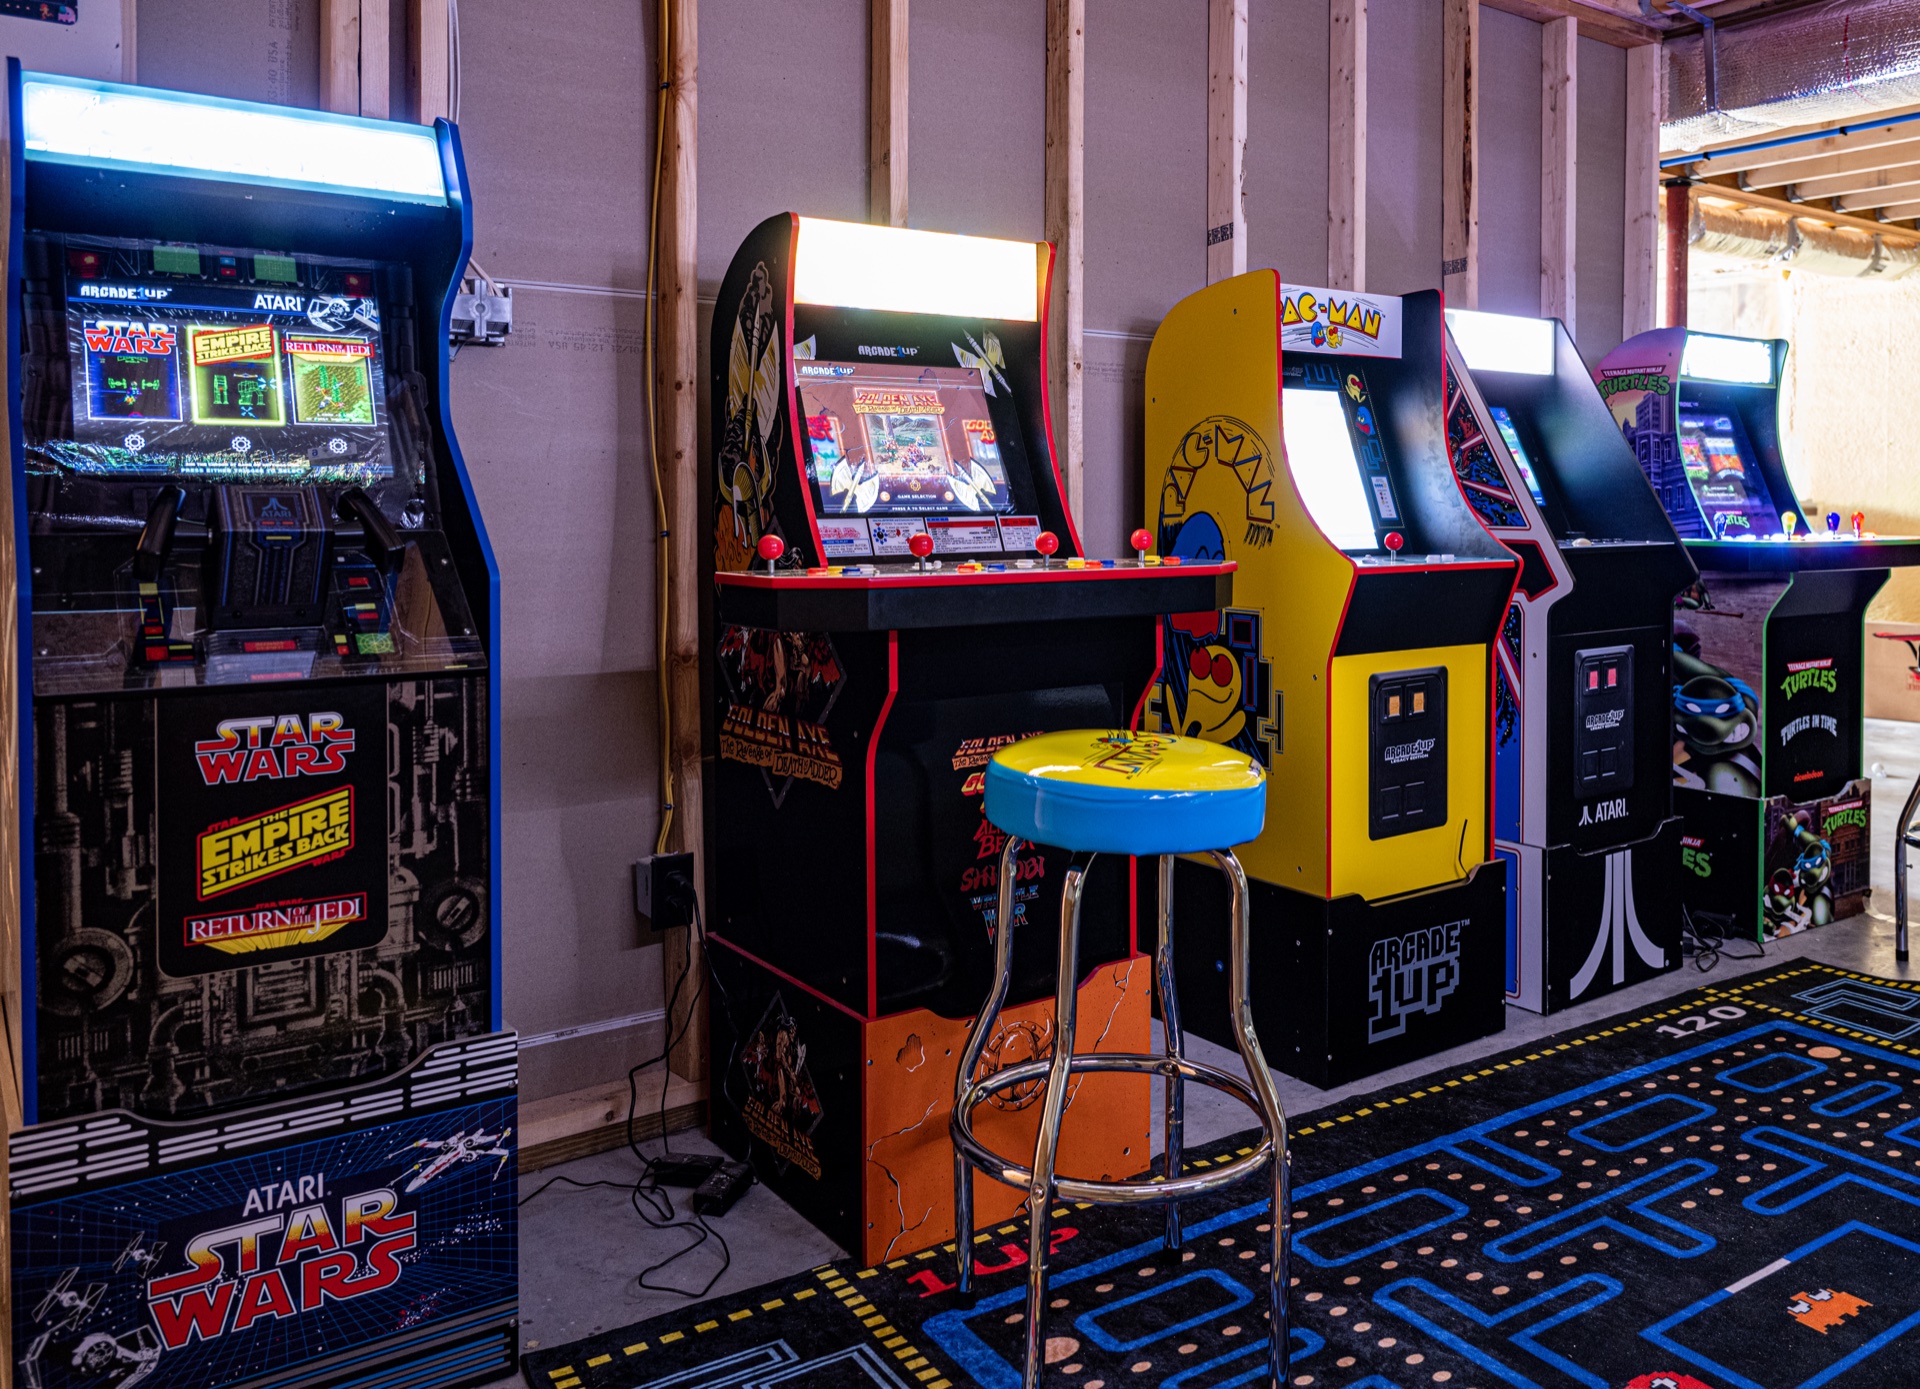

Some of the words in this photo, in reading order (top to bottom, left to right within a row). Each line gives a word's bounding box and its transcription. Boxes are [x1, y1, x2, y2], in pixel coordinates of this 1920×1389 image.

[268, 41, 278, 63] USA
[254, 294, 302, 312] ATARI
[1280, 291, 1382, 340] AC-MAN
[85, 320, 175, 339] STAR
[86, 336, 177, 355] WARS
[195, 329, 272, 352] EMPIRE
[548, 341, 568, 350] USA
[196, 347, 243, 360] STRIKES
[244, 341, 271, 357] BACK
[286, 341, 335, 353] RETURN
[345, 343, 370, 359] JEDI
[854, 392, 911, 407] GOLDEN
[911, 394, 944, 407] AXE
[1598, 373, 1670, 400] TURTLES
[966, 419, 992, 432] GOL
[1780, 667, 1837, 701] TURTLES
[195, 711, 355, 755] STAR
[723, 704, 793, 752] GOLDEN
[796, 719, 840, 763] AXE
[955, 735, 1017, 756] GOLDEN
[1780, 714, 1810, 747] TURTLES
[1811, 714, 1820, 728] IN
[1820, 714, 1837, 738] TIME
[196, 739, 355, 786] WARS
[722, 739, 735, 755] The
[736, 741, 764, 761] Revenge
[775, 755, 803, 777] DEATH
[805, 760, 838, 787] ADDER
[208, 816, 239, 834] STAR
[261, 809, 288, 825] THE
[1595, 798, 1627, 824] ATARI
[1823, 808, 1867, 837] TURTLES
[202, 798, 350, 871] EMPIRE
[202, 841, 293, 888] STRIKES
[297, 823, 350, 855] BACK
[312, 850, 346, 867] WARS
[960, 856, 1045, 892] SHIOBI
[190, 907, 294, 941] RETURN
[293, 905, 308, 916] OF
[307, 898, 361, 935] JEDI
[982, 903, 1029, 945] WR
[1369, 921, 1460, 977] ARCADE
[1368, 957, 1460, 1045] 1UP
[1656, 1005, 1747, 1039] 120
[242, 1172, 325, 1217] ATARI
[148, 1187, 417, 1300] STAR
[150, 1233, 417, 1352] WARS
